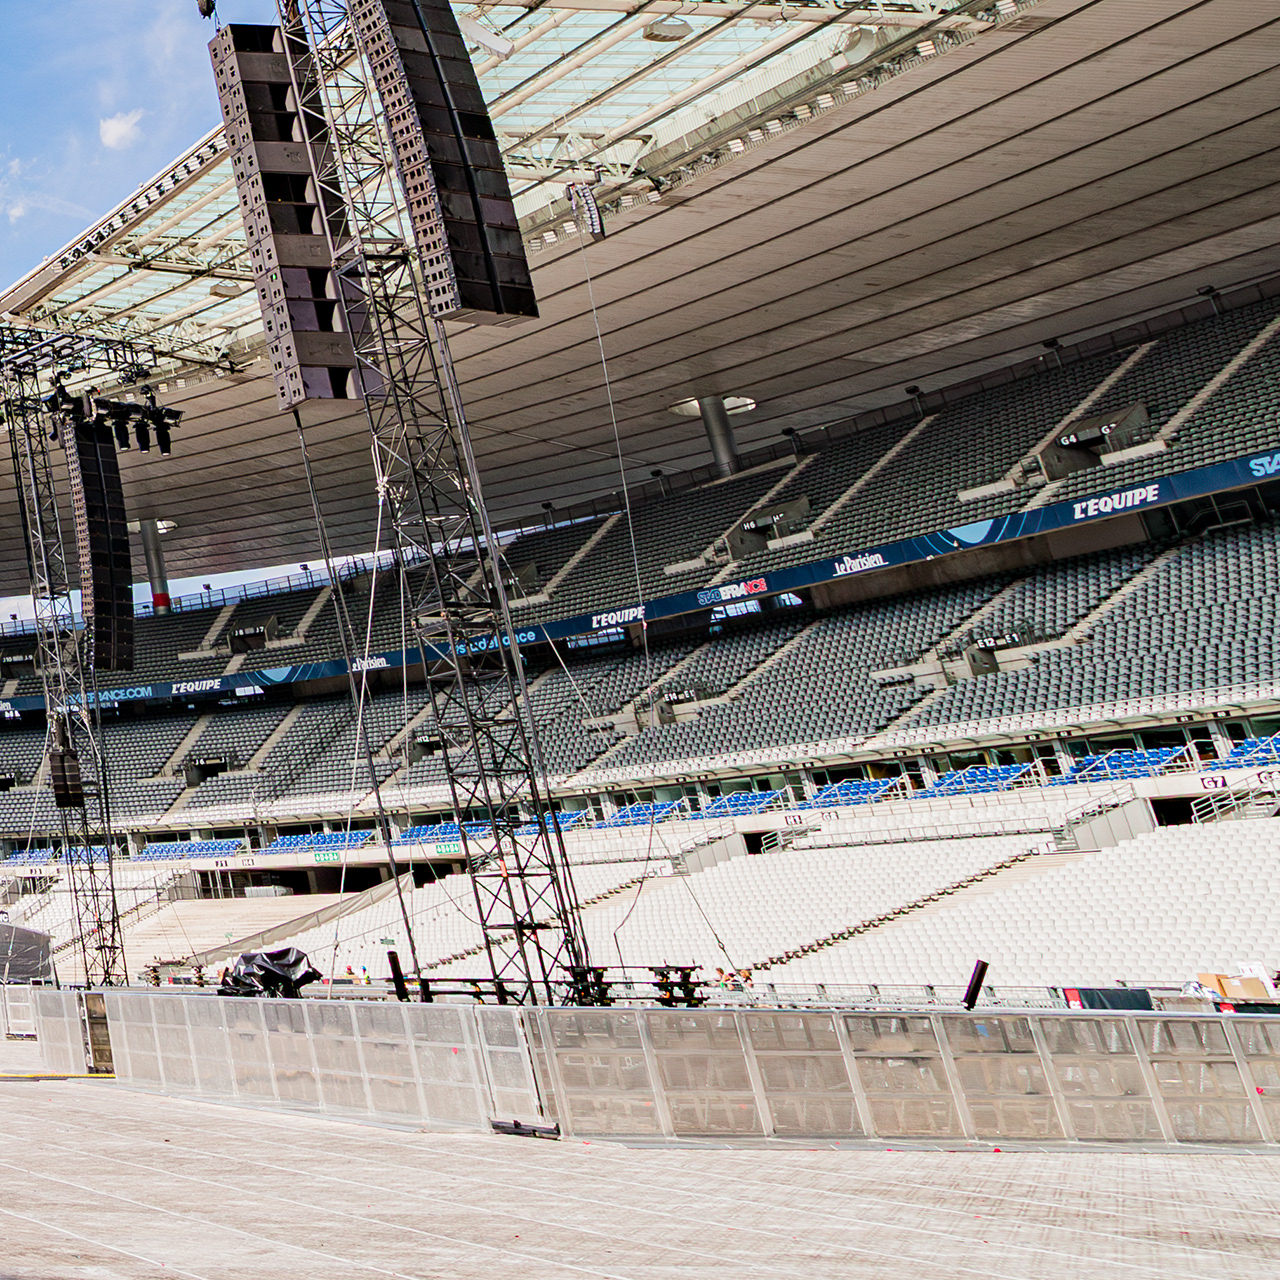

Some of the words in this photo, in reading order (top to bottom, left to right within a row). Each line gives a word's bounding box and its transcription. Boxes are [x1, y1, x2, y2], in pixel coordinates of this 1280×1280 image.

[1060, 434, 1077, 446] G4
[743, 521, 756, 529] H6
[977, 637, 996, 648] E12
[1204, 776, 1225, 788] G7
